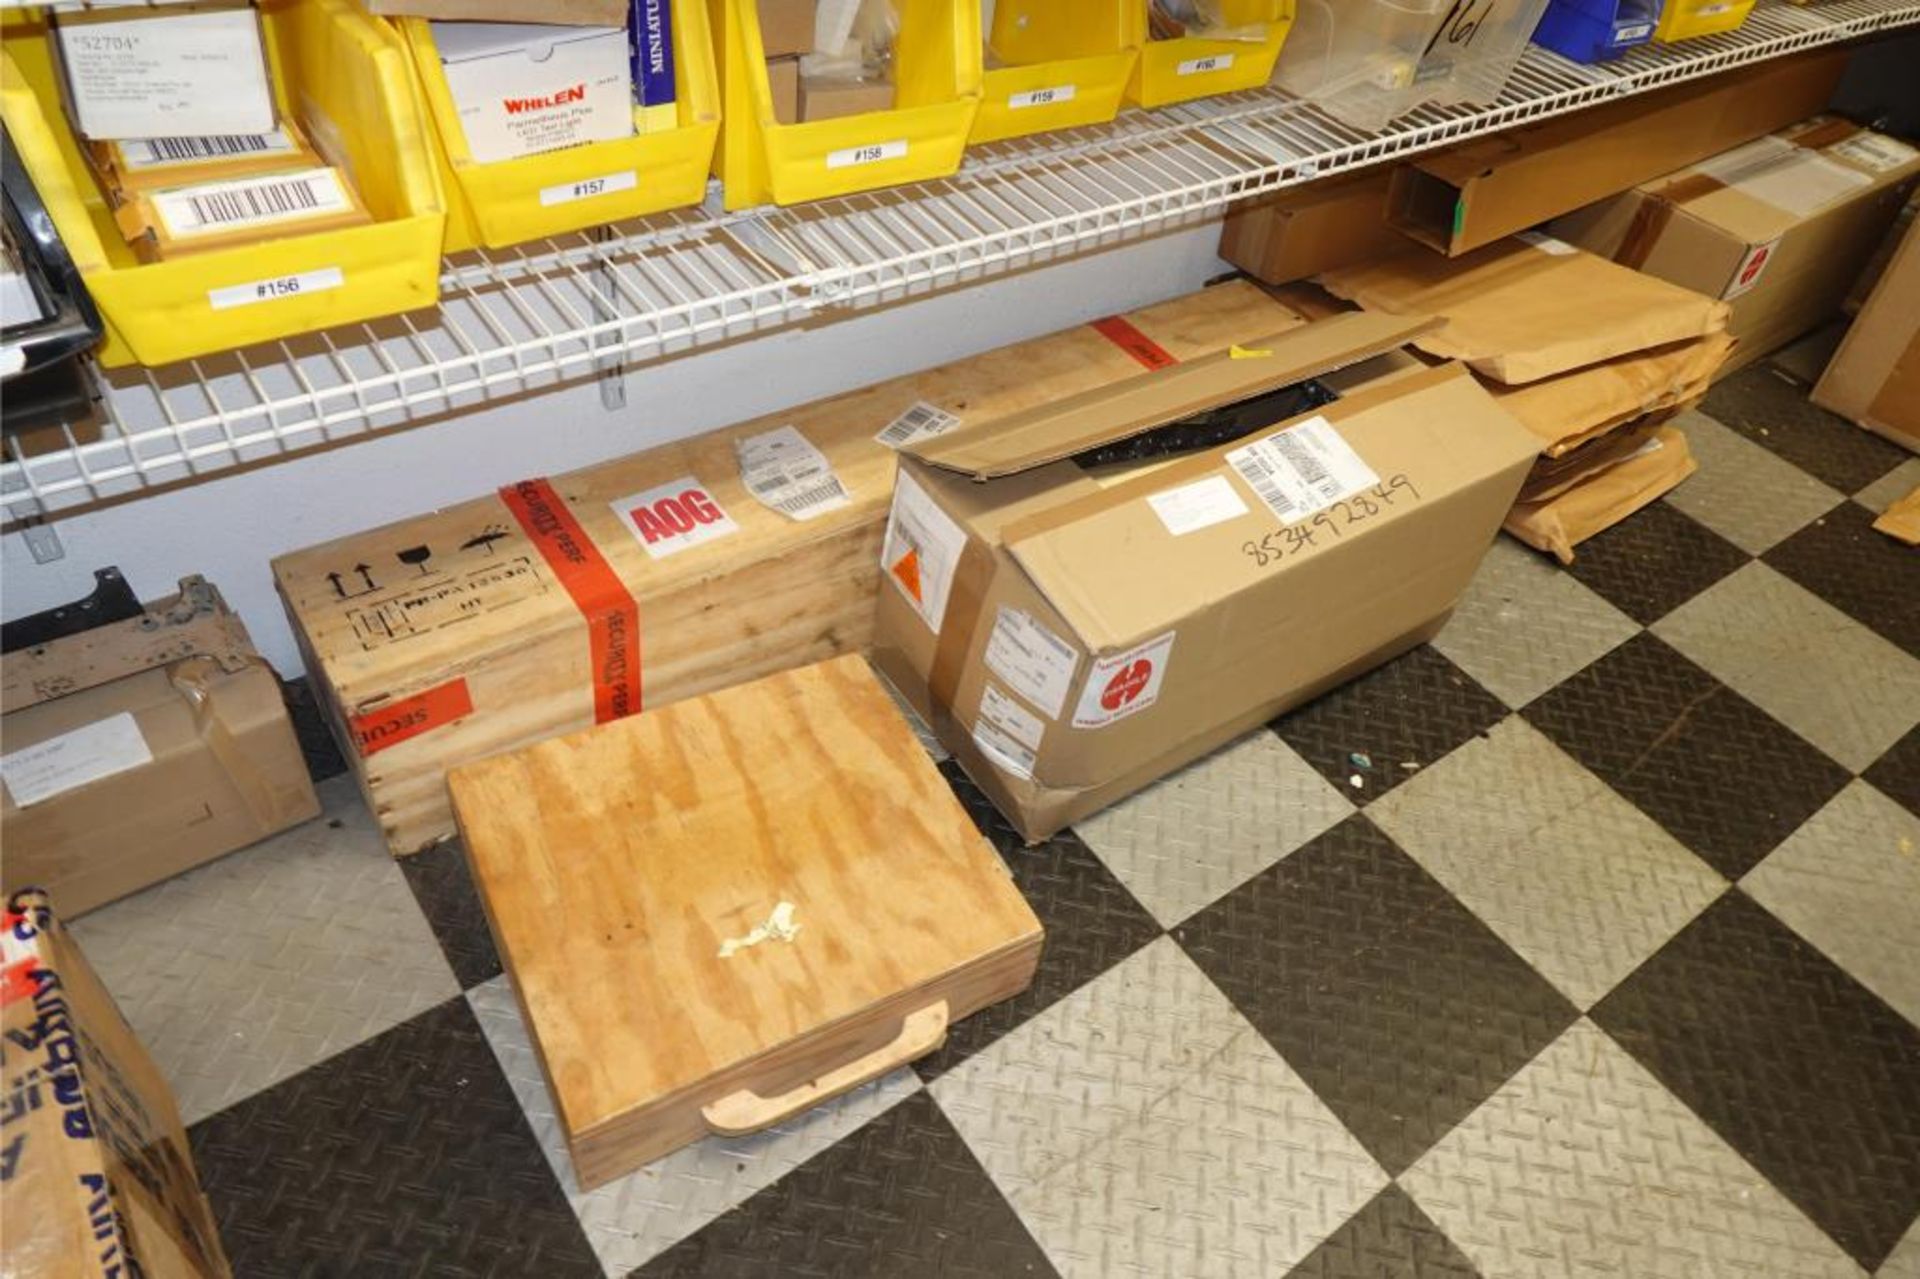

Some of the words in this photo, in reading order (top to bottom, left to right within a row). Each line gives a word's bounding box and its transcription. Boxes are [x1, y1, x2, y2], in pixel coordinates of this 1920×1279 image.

[504, 84, 585, 114] WHELEN
[854, 146, 883, 162] #158
[574, 179, 605, 196] #157
[257, 277, 299, 297] #156
[629, 489, 723, 545] AOG
